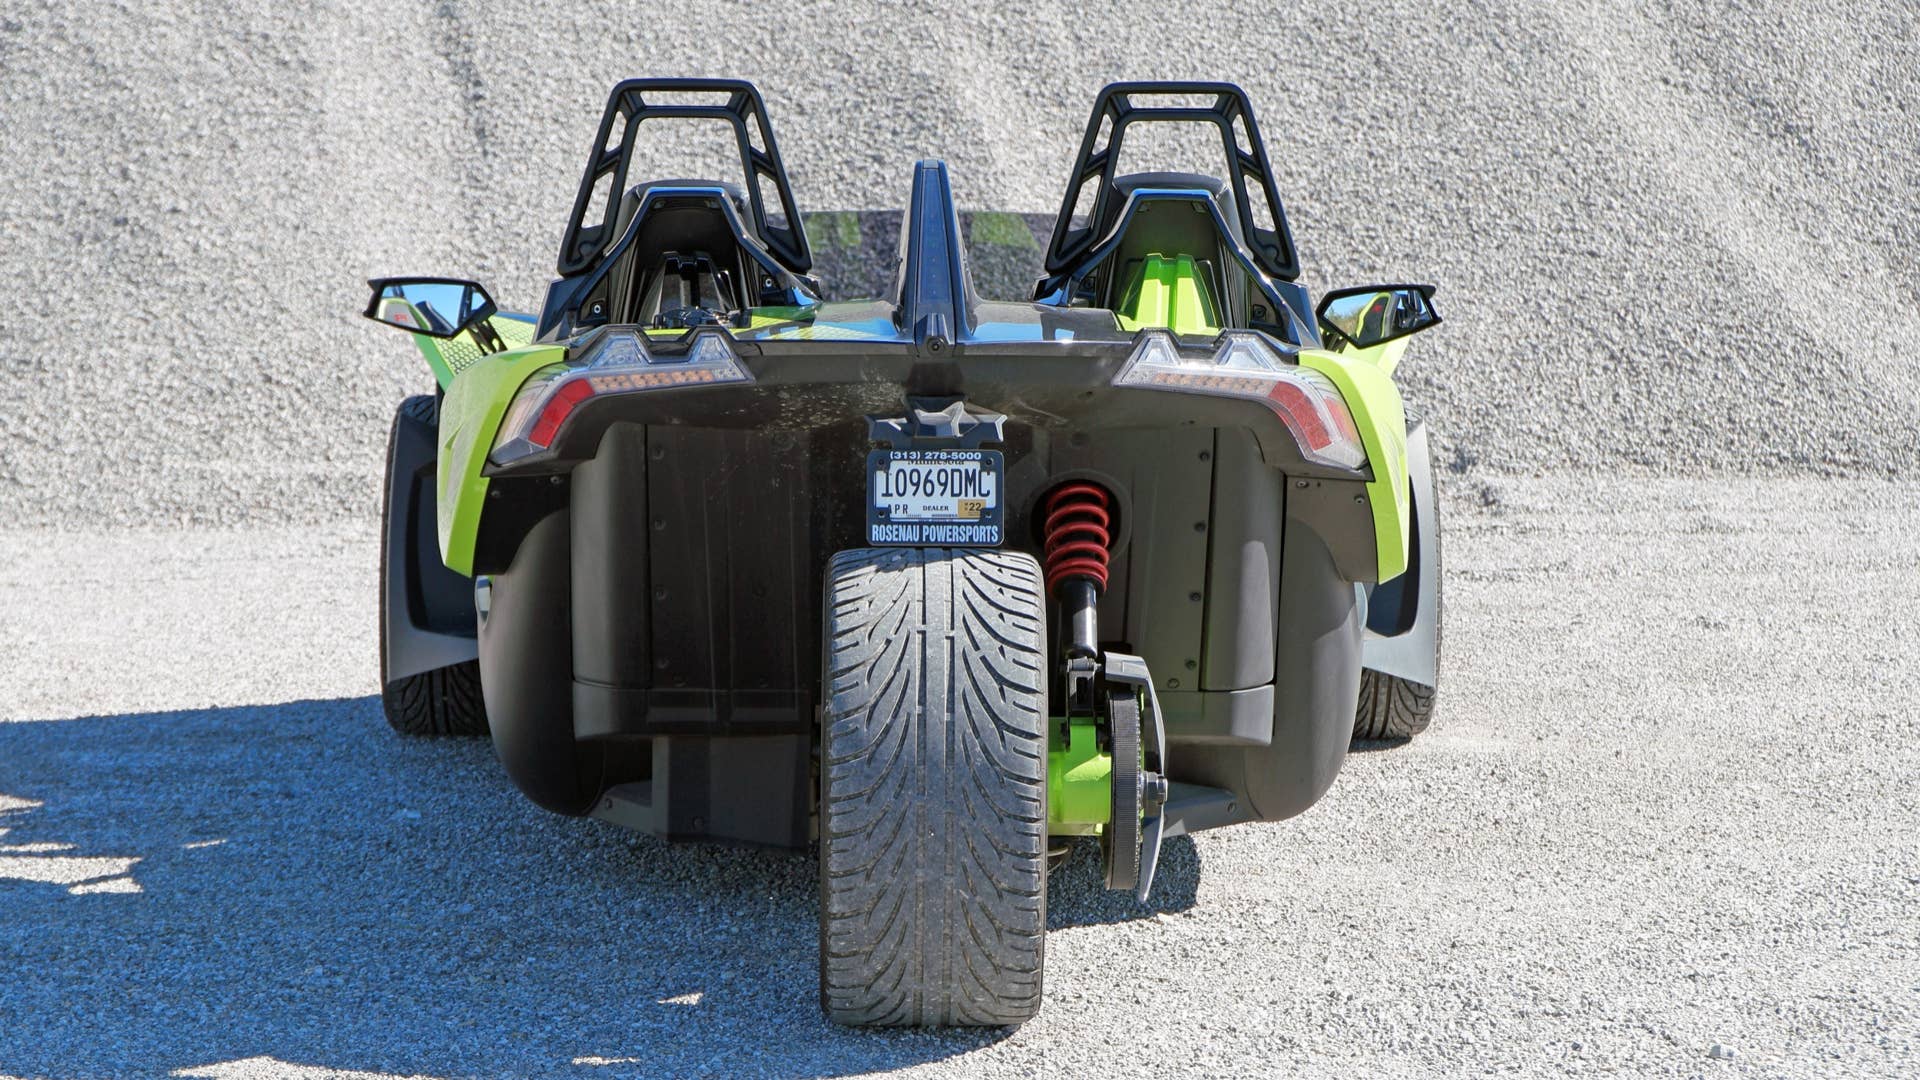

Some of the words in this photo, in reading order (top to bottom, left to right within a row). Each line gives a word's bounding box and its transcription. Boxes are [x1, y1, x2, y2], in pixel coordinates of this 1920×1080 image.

[890, 451, 921, 460] (313)
[925, 451, 982, 460] 278-5000
[881, 468, 991, 497] 10969DMC
[872, 524, 920, 542] ROSENAU
[922, 525, 998, 542] POWERSPORTS
